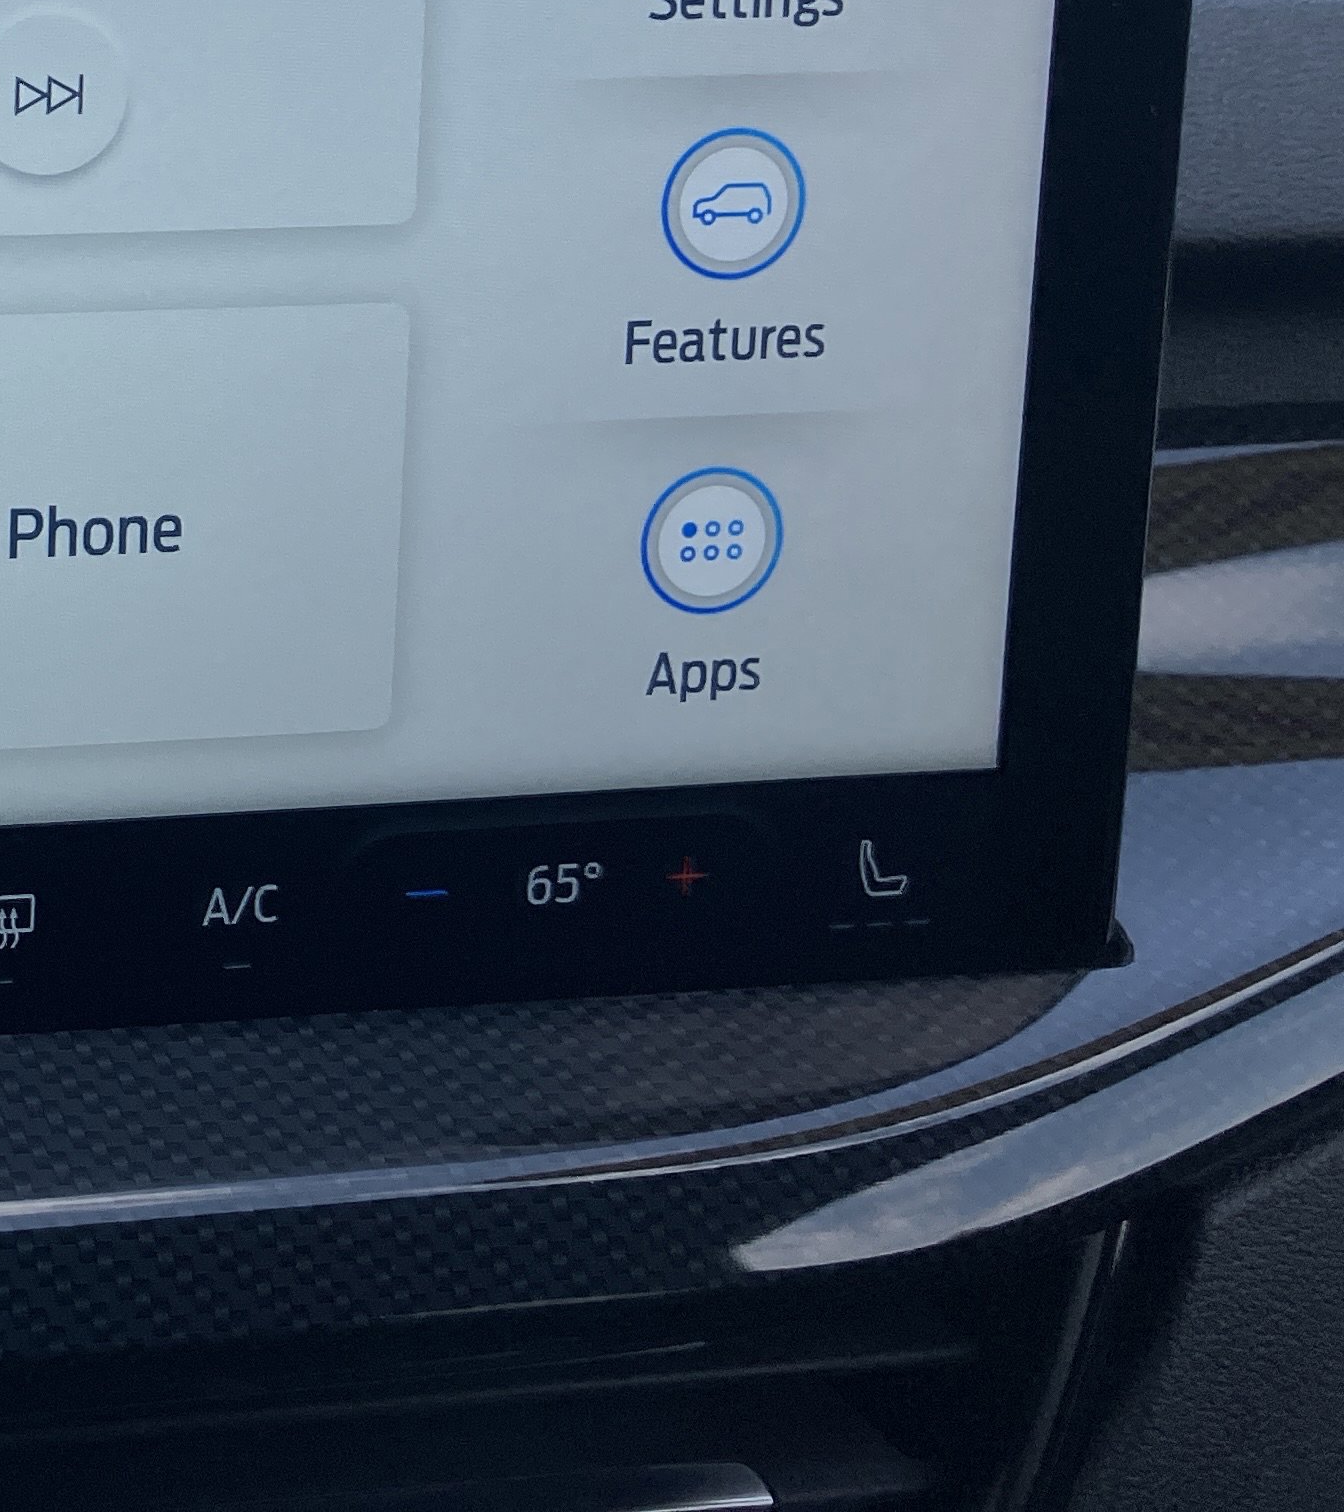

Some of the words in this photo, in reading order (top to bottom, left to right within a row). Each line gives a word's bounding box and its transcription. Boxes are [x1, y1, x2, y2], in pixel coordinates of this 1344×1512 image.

[624, 317, 827, 365] Features
[9, 504, 182, 561] Phone
[645, 650, 761, 703] Apps
[202, 883, 278, 927] A/C
[526, 860, 603, 907] 65°
